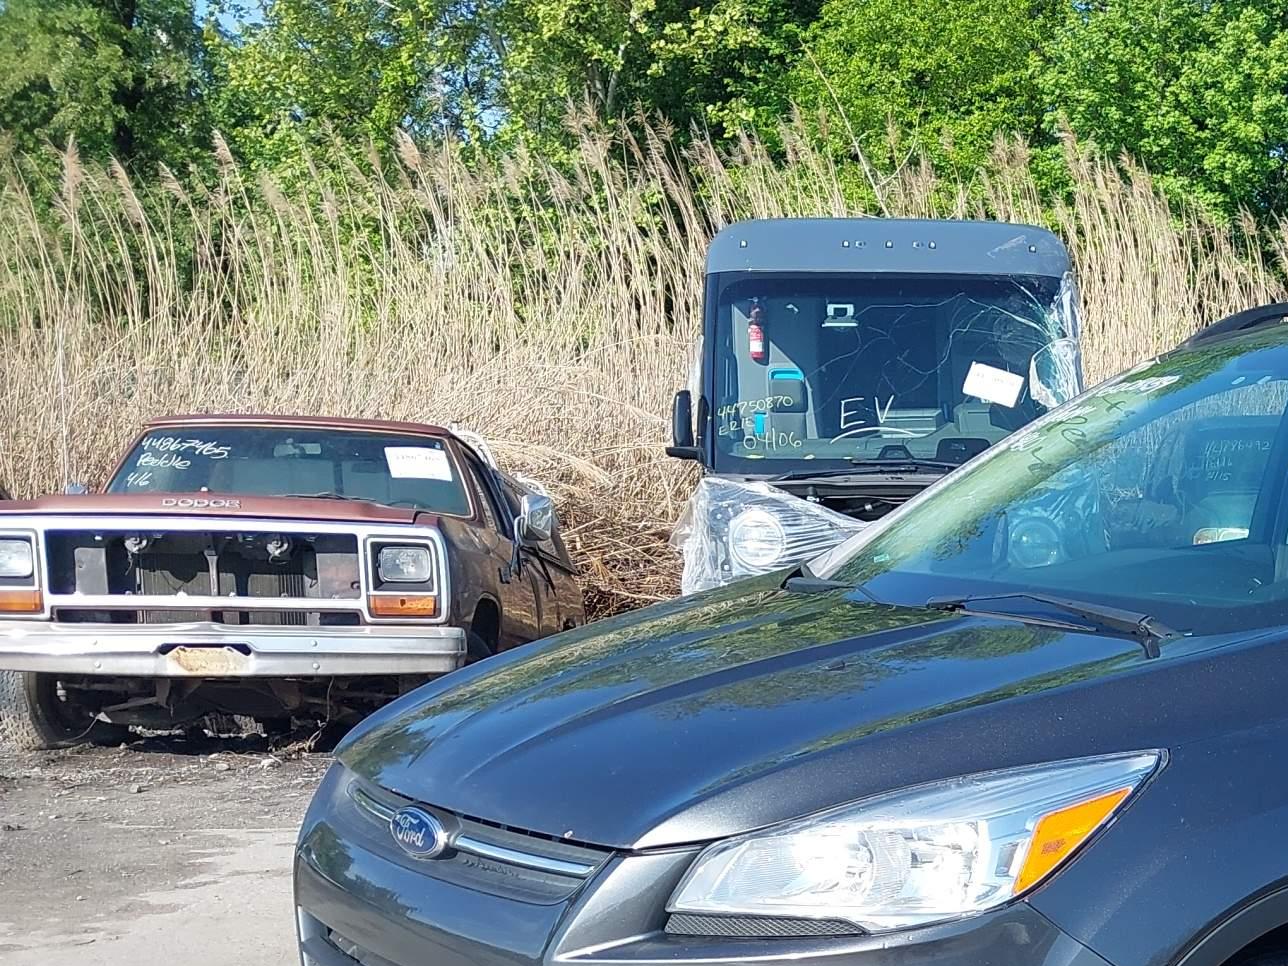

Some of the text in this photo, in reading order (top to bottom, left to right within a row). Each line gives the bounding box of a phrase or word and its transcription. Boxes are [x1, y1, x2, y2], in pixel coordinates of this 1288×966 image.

[717, 395, 793, 418] 44750870
[718, 416, 756, 436] ERIE
[141, 436, 231, 459] 44867465
[743, 428, 802, 451] 04/06
[162, 498, 242, 509] DODGE
[395, 813, 426, 847] Ford
